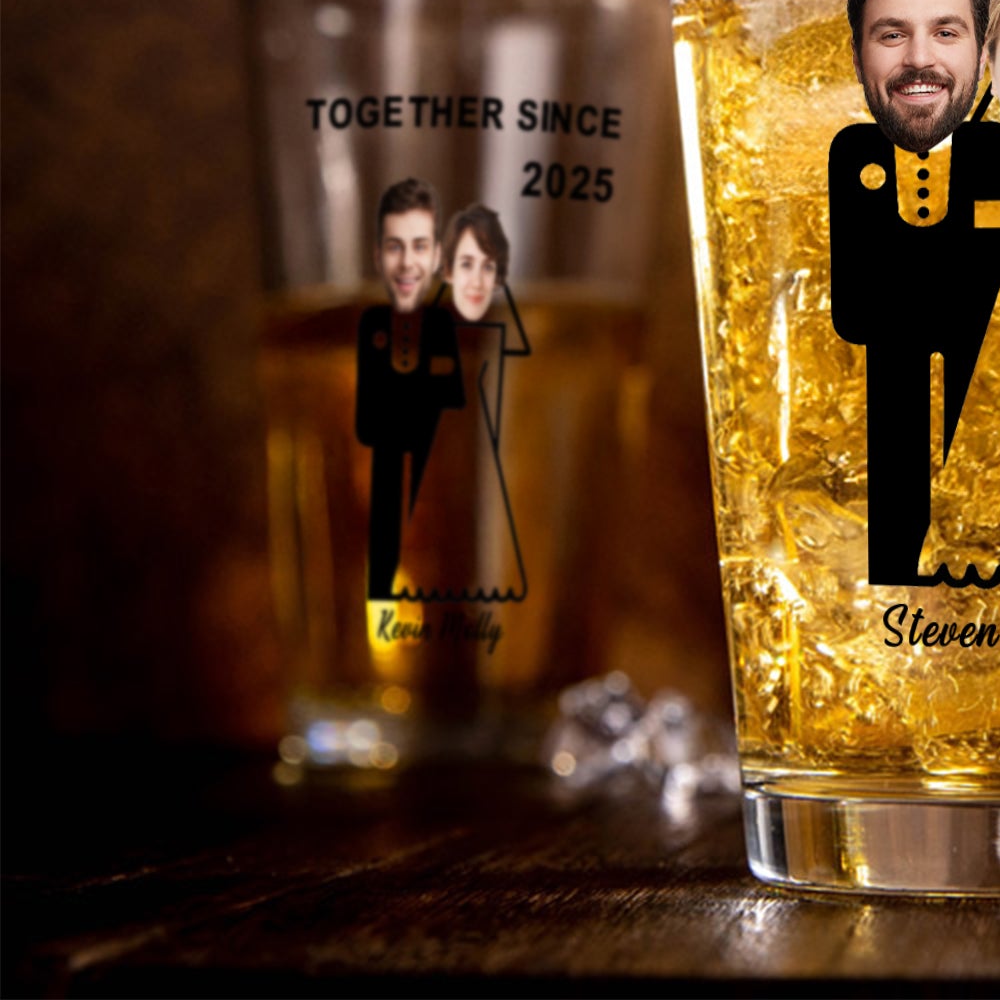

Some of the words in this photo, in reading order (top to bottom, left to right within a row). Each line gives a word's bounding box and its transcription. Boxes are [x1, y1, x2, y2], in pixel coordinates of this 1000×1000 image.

[306, 96, 503, 130] TOGETHER
[517, 99, 622, 139] SINCE
[521, 161, 614, 203] 2025
[376, 608, 432, 642] Kevin
[883, 603, 1000, 648] Steven
